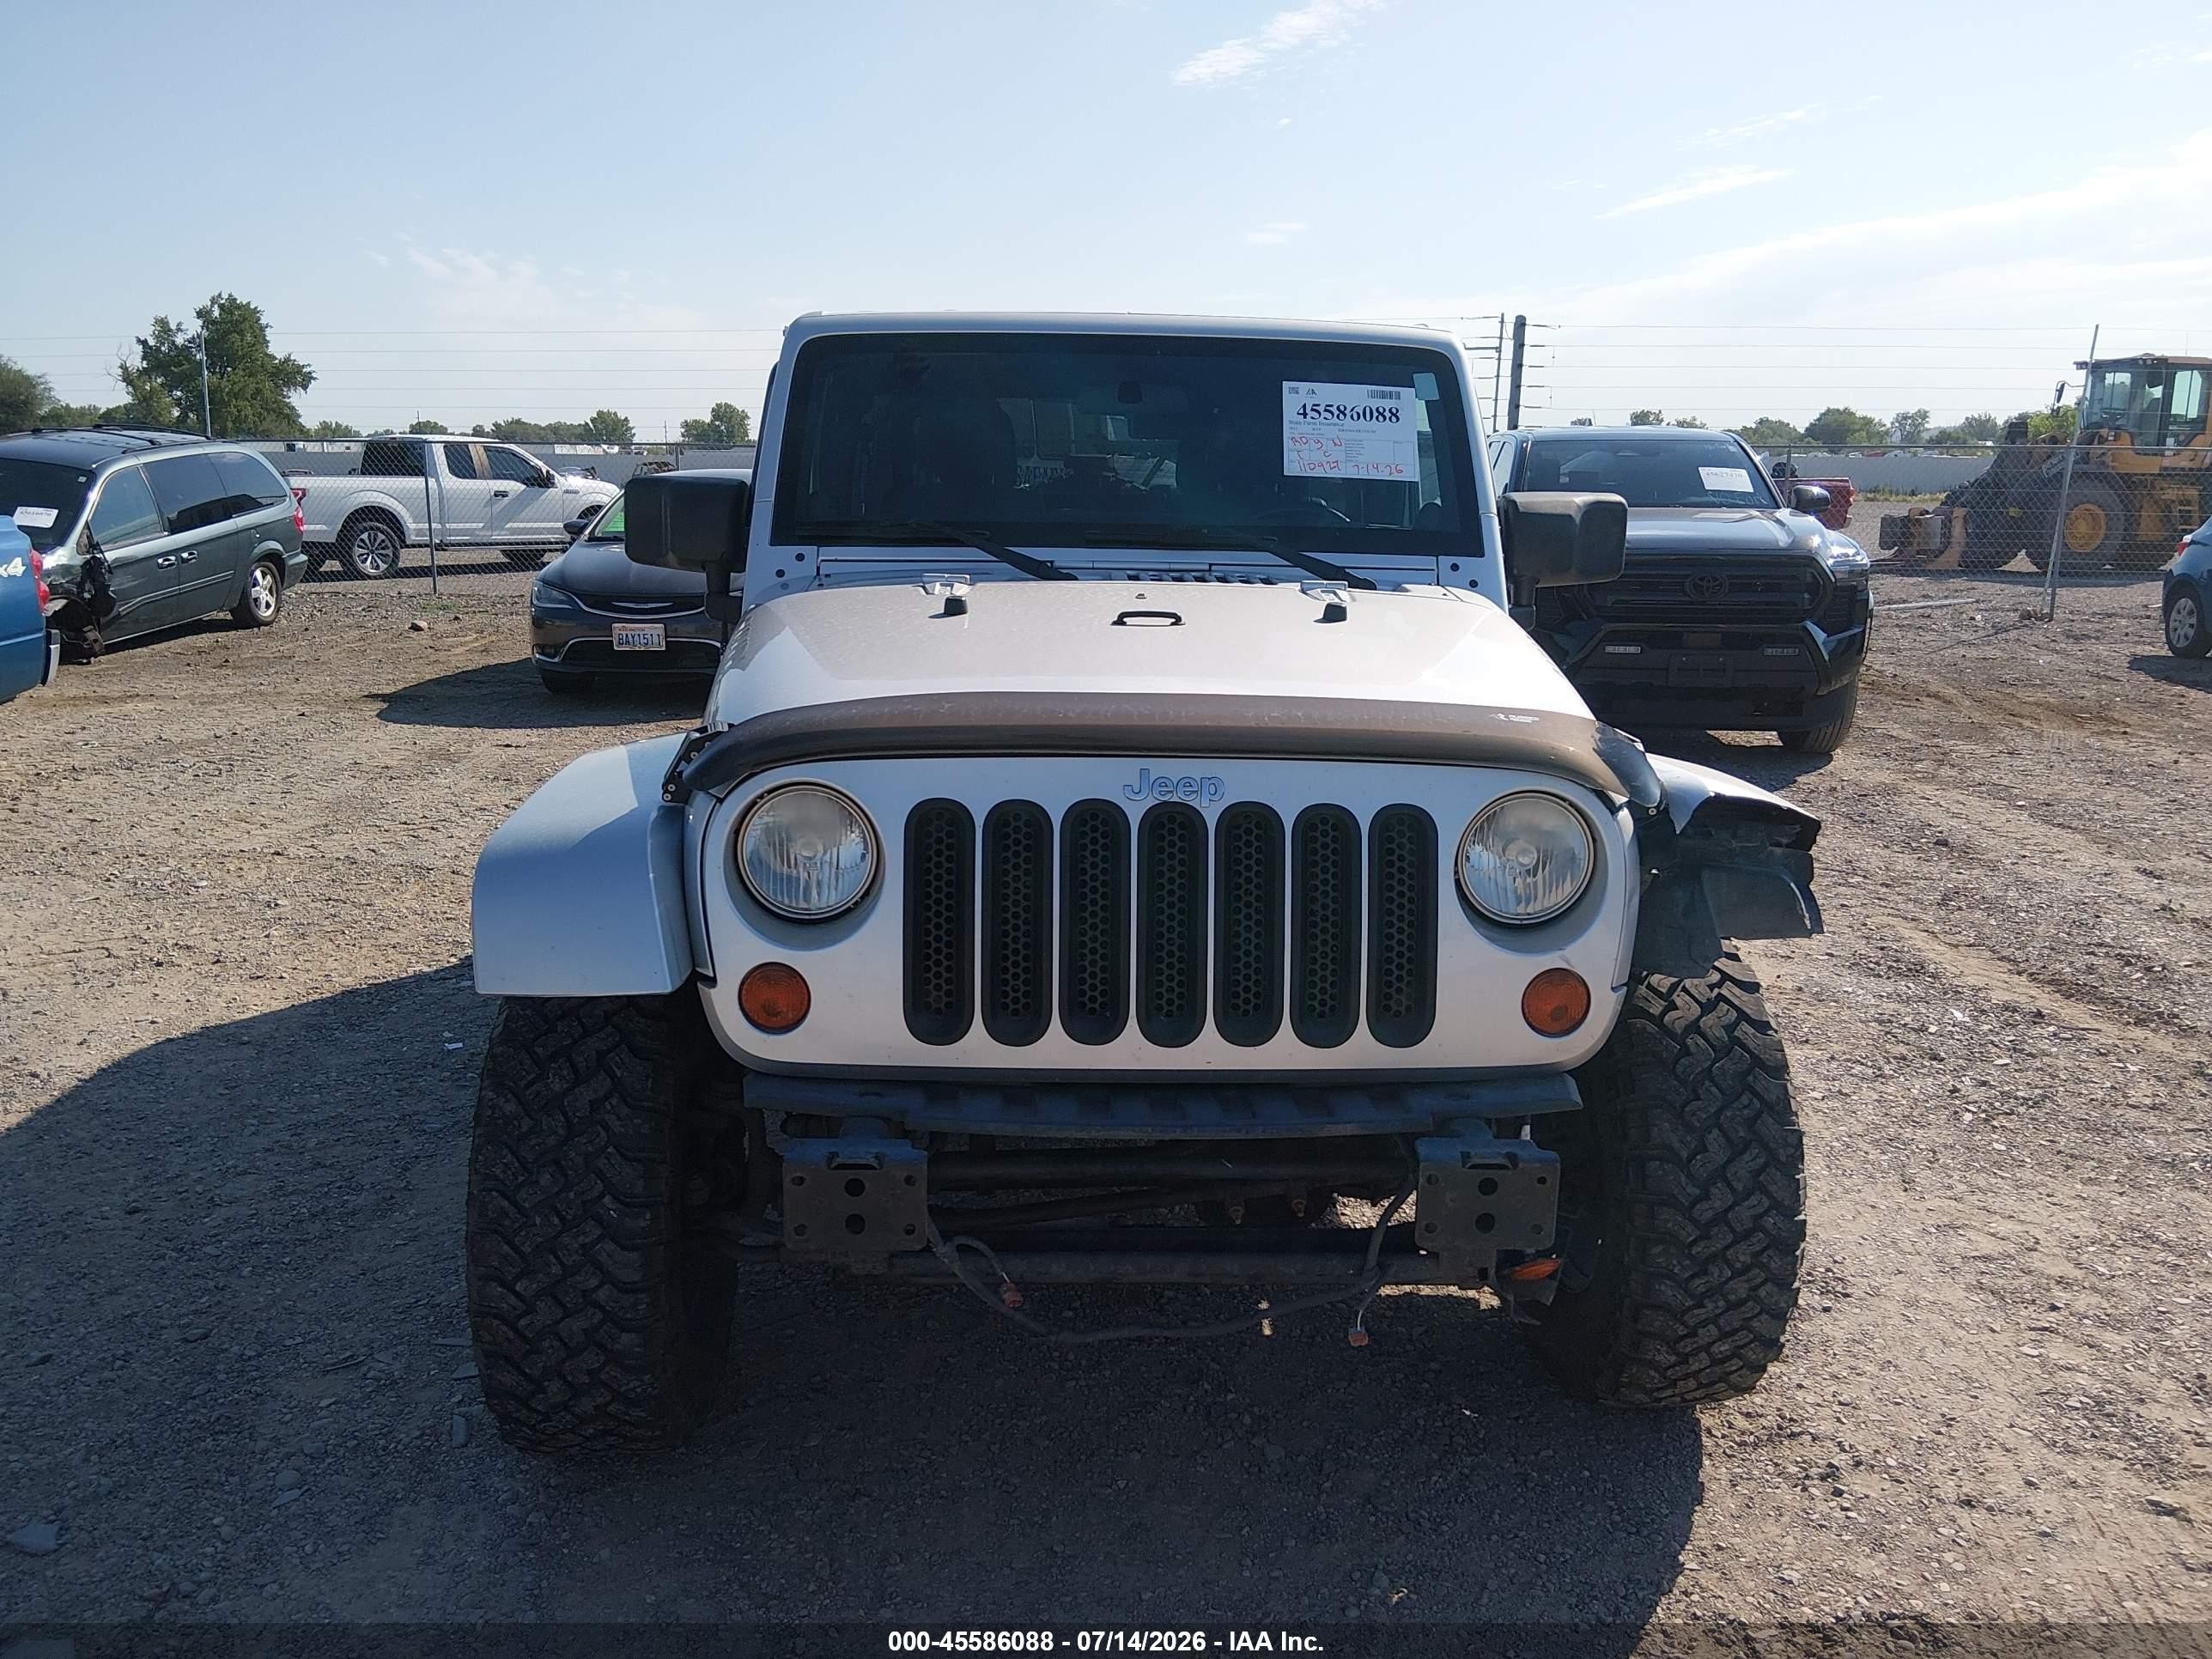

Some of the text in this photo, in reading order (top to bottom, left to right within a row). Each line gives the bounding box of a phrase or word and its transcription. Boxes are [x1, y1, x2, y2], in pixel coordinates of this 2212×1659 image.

[1297, 402, 1401, 423] 45586088
[618, 633, 660, 646] BAY1511
[1123, 768, 1224, 808] Jeep
